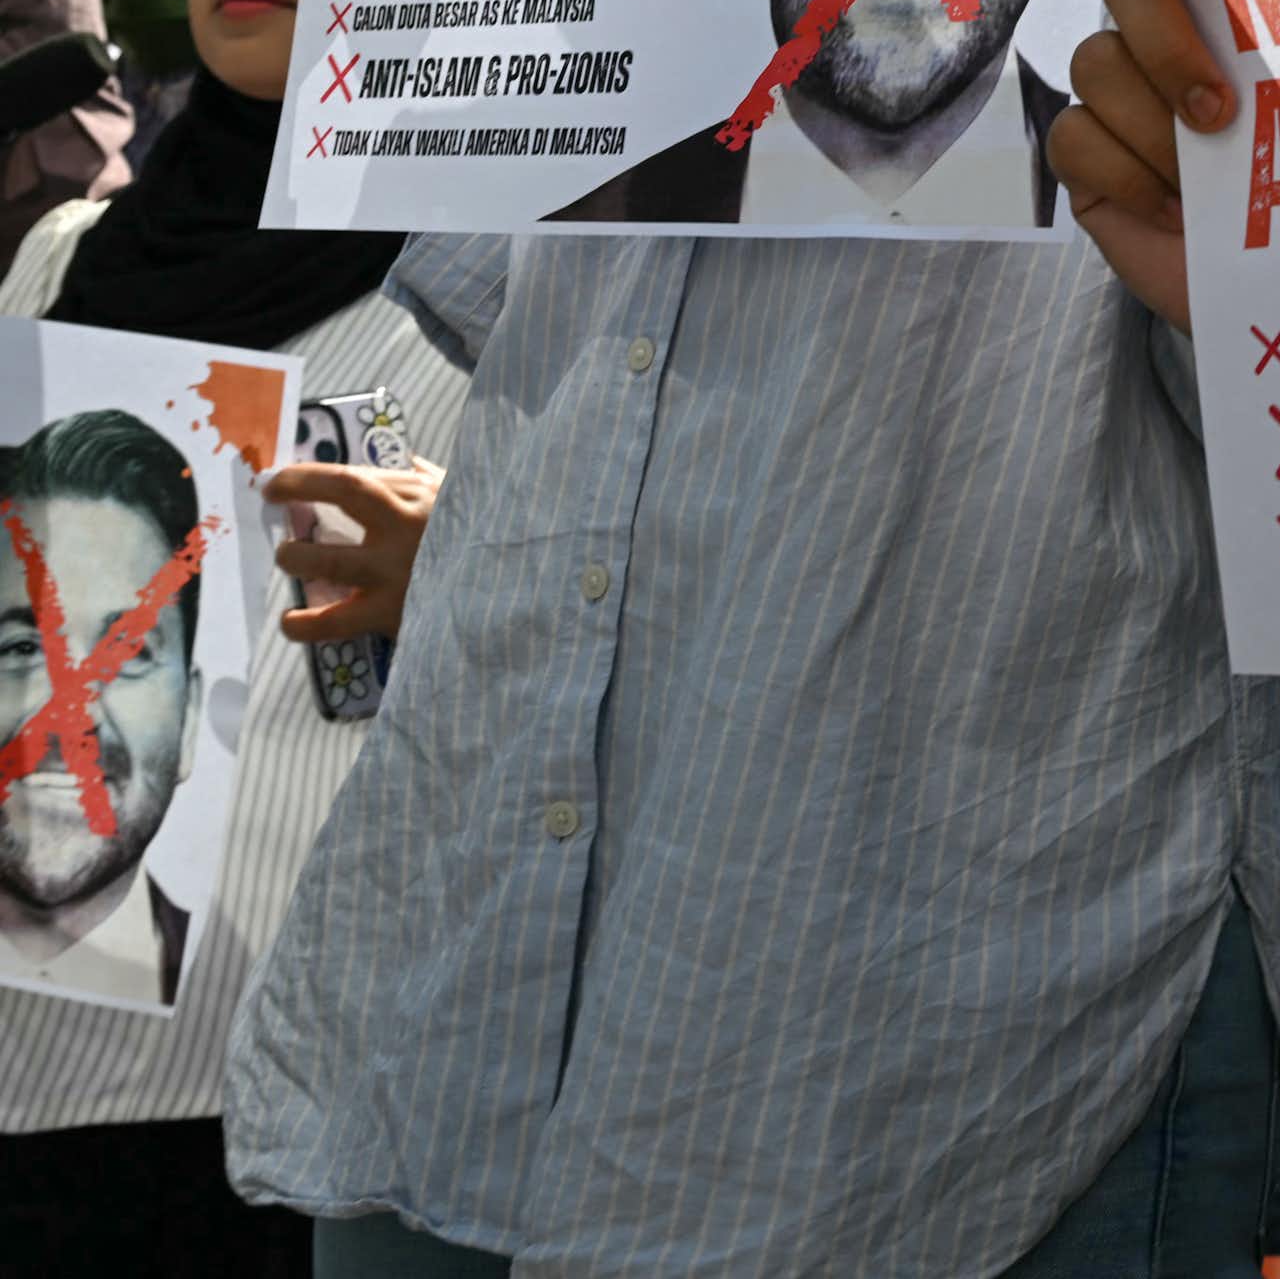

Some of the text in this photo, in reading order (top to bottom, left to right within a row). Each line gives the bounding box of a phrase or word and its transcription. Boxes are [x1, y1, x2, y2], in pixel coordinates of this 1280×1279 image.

[352, 3, 395, 32] CALON
[397, 1, 432, 30] DUTA
[433, 0, 480, 28] BESAR
[479, 0, 501, 26] AS
[358, 50, 634, 99] ANTI-ISLAM & PRO-ZIONIS
[332, 126, 628, 156] TIDAK LAYAK WAKILI AMERIKA DI MALAYSIA
